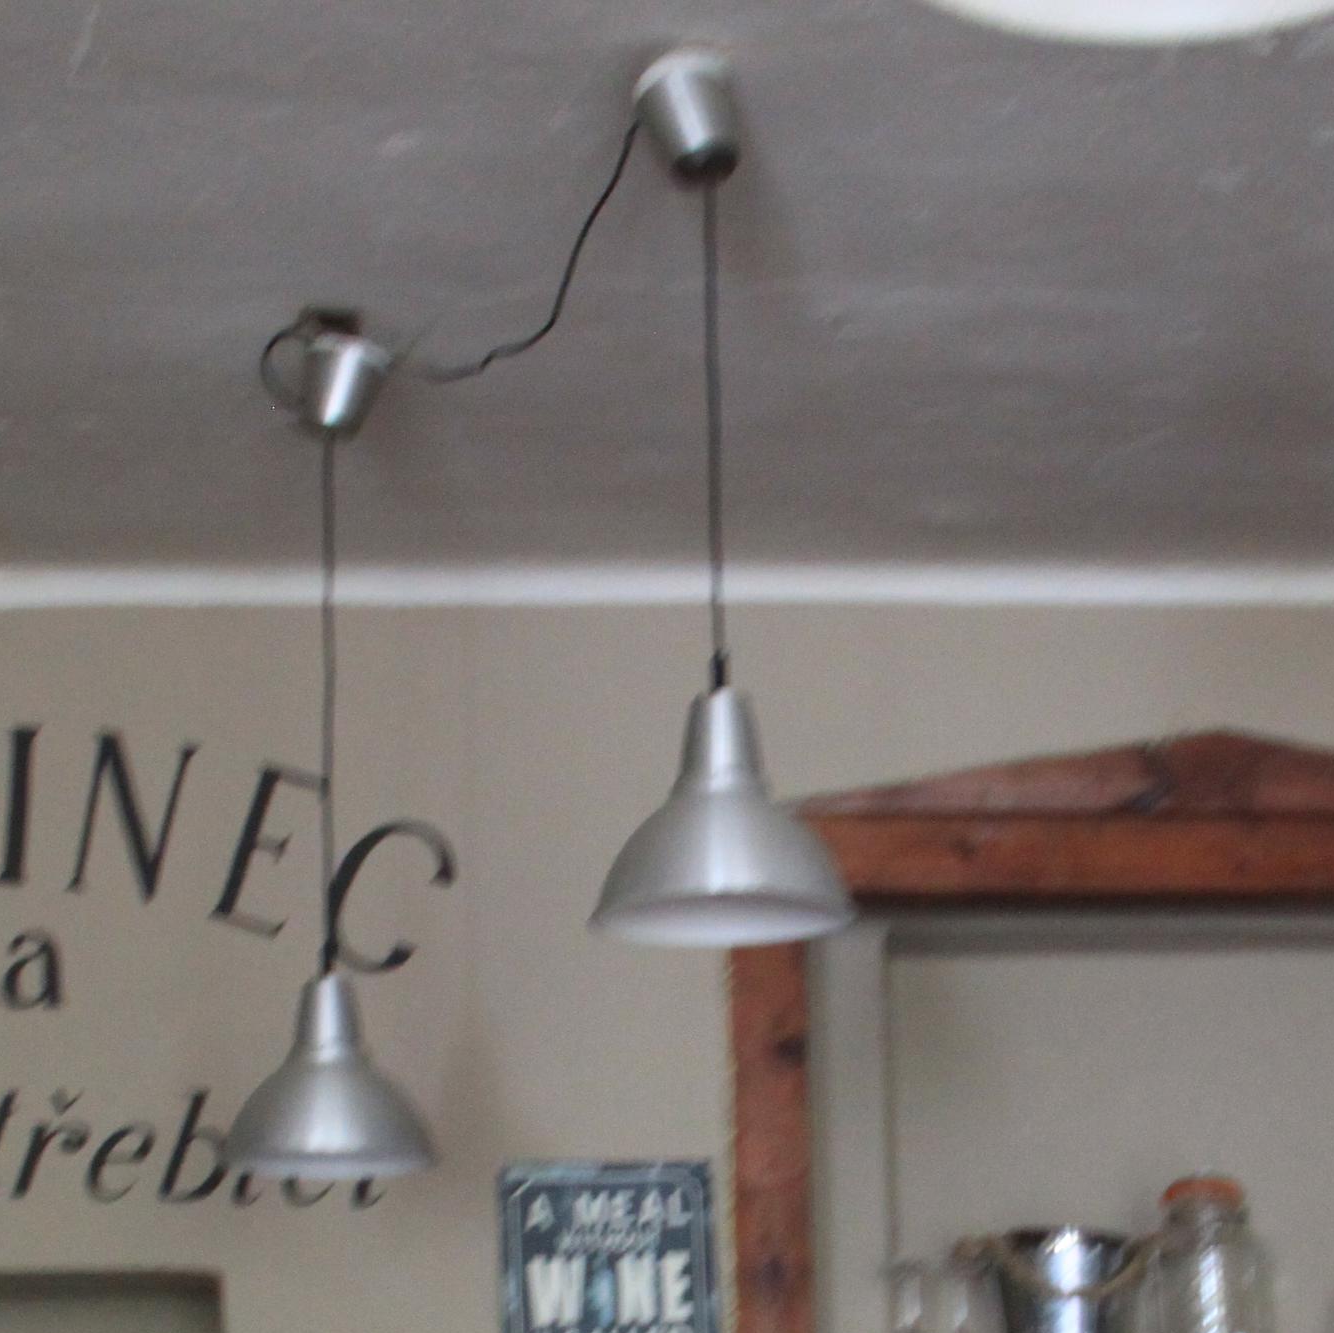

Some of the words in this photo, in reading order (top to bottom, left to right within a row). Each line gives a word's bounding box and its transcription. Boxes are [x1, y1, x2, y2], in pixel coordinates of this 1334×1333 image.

[524, 1191, 557, 1232] A
[571, 1187, 693, 1231] MEAL
[525, 1250, 695, 1328] WINE
